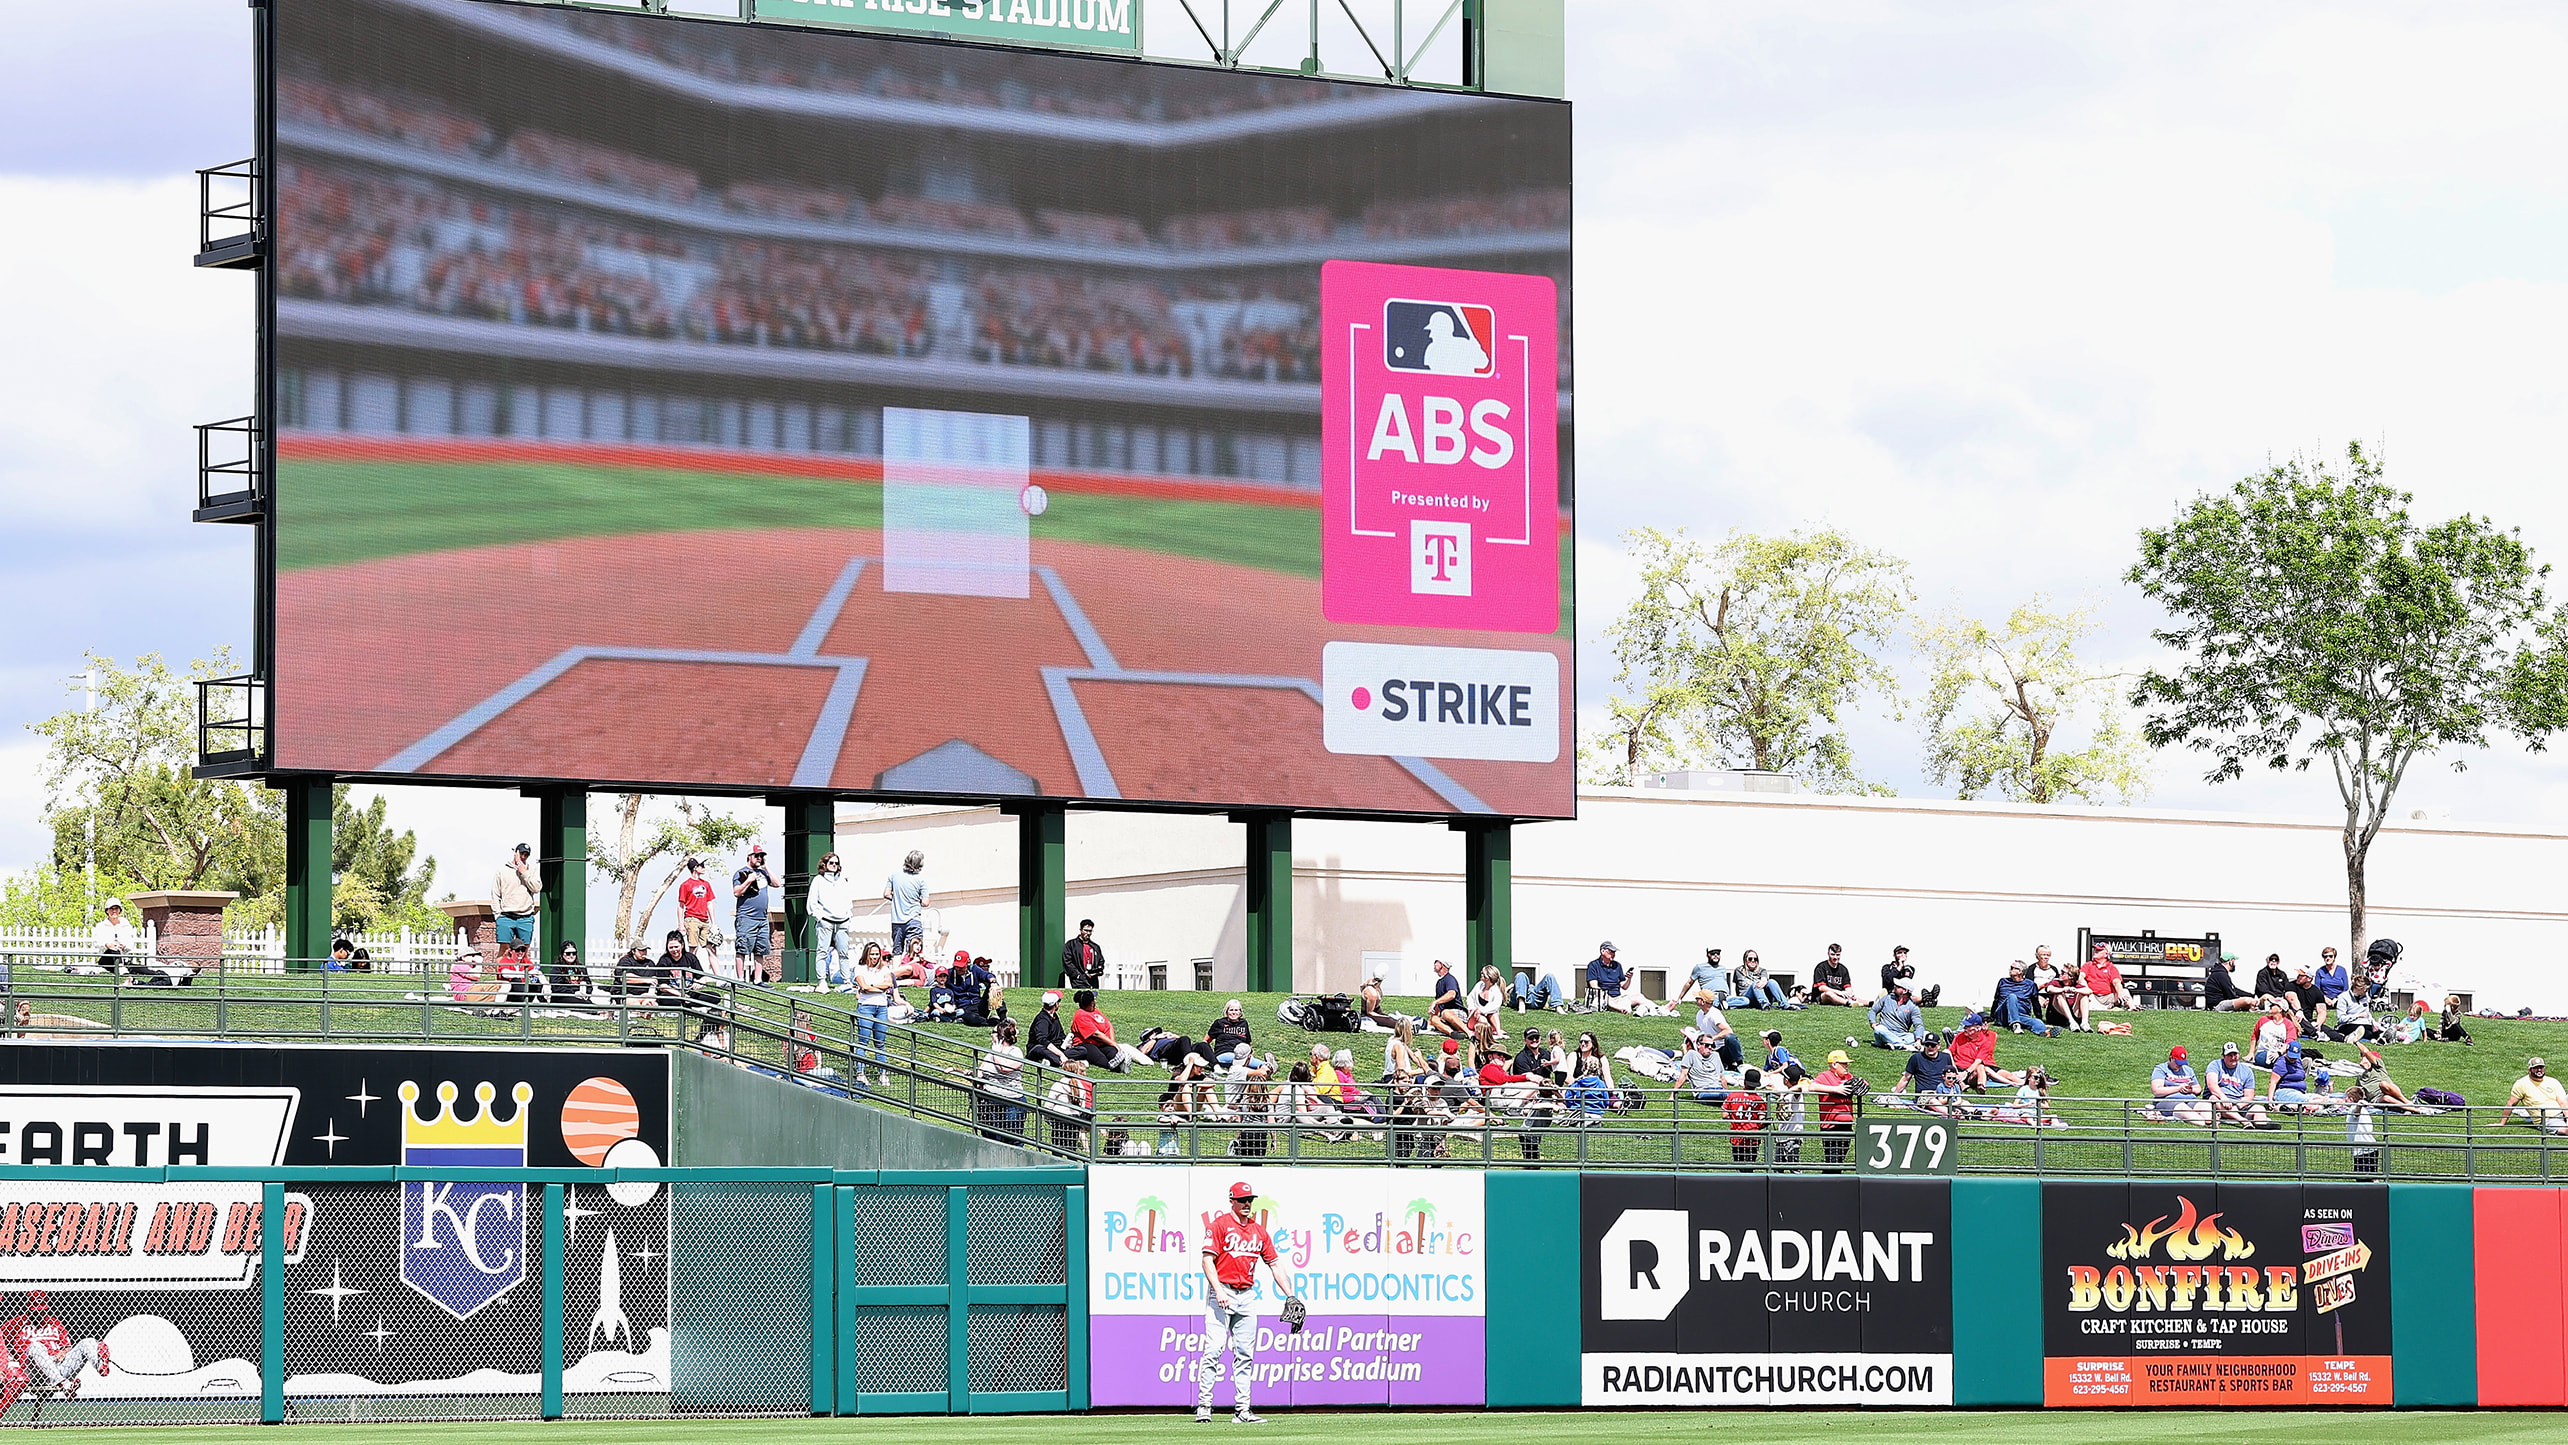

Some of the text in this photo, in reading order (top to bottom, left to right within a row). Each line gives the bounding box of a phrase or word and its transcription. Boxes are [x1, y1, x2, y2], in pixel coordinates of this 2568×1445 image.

[961, 0, 1131, 34] STADIUM
[1366, 393, 1514, 469] ABS
[1391, 490, 1490, 511] Presented by
[1381, 679, 1532, 727] STRIKE
[2108, 941, 2137, 952] WALK
[2138, 941, 2164, 953] THRU
[1736, 1105, 1752, 1121] 44
[0, 1122, 208, 1166] ARTH
[1868, 1124, 1948, 1170] 379
[2303, 1209, 2353, 1219] AS SEEN ON
[0, 1202, 306, 1256] ASEBALL AND BER
[413, 1182, 514, 1274] KC
[1104, 1209, 1186, 1253] Palm
[1322, 1210, 1474, 1256] Pediatric
[2306, 1230, 2350, 1247] Diners
[1223, 1232, 1264, 1252] Reds
[1629, 1240, 1660, 1289] R
[1699, 1229, 1934, 1282] RADIANT
[2309, 1248, 2361, 1279] DRIVE-INS
[1272, 1272, 1474, 1302] ORTHODONTICS
[2067, 1265, 2298, 1312] BONFIRE
[1764, 1290, 1871, 1313] CHURCH
[2081, 1318, 2289, 1334] CRAFT KITCHEN & TAP HOUSE
[1256, 1327, 1333, 1352] Dental
[1336, 1327, 1422, 1352] Partner
[2135, 1339, 2222, 1350] SURPRISE TEMPE
[1158, 1356, 1188, 1382] of
[1229, 1357, 1325, 1388] urprise
[1328, 1355, 1422, 1382] Stadium
[2076, 1362, 2125, 1371] SURPRISE
[2145, 1364, 2296, 1376] YOUR FAMILY NEIGHBORHOOD
[2309, 1372, 2371, 1381] 15332 W. Bell Rd.
[2324, 1361, 2355, 1370] TEMPE
[1602, 1366, 1933, 1393] RADIANTCHURCH.COM
[2069, 1373, 2132, 1383] 15332 W. Bell Rd.
[2073, 1385, 2129, 1394] 623-295-4567
[2149, 1379, 2293, 1392] RESTAURANT & SPORTS BAR
[2312, 1383, 2368, 1393] 623-295-4567
